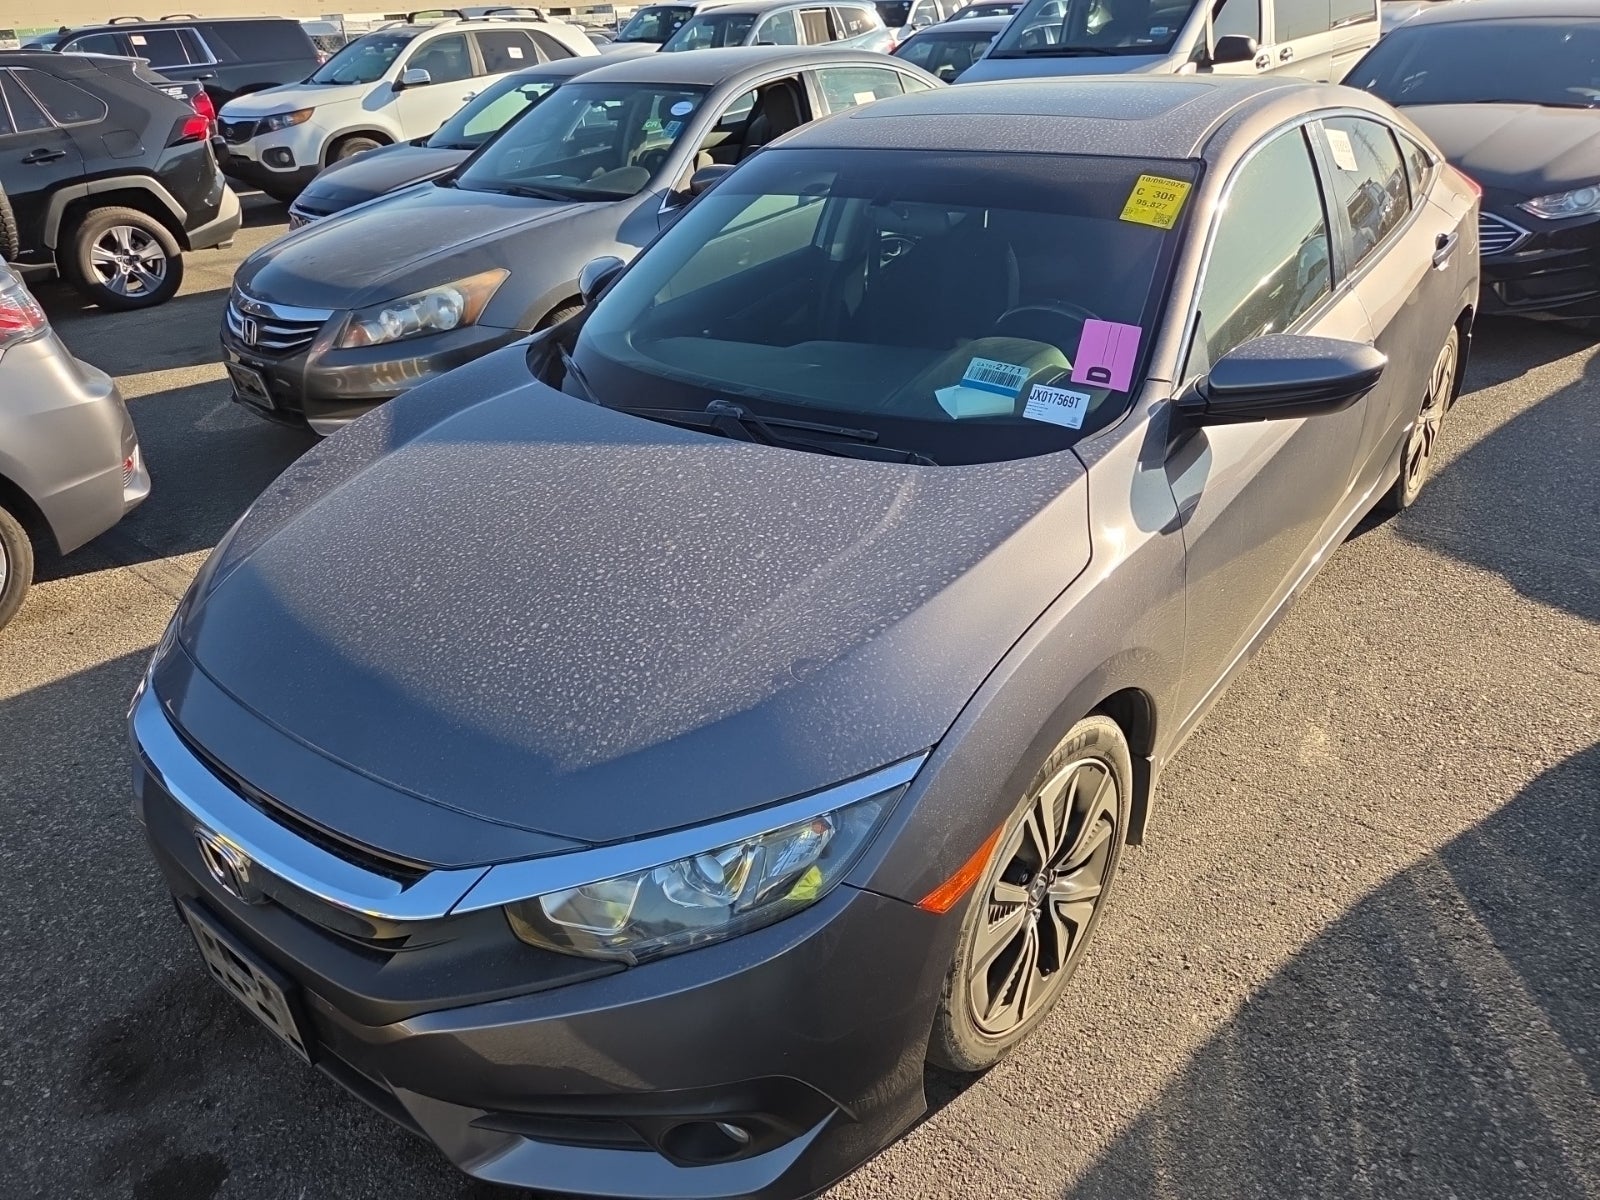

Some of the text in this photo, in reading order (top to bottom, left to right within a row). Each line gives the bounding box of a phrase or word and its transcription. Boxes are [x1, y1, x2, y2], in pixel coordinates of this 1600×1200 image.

[1136, 187, 1146, 196] C
[1152, 190, 1177, 202] 308
[1085, 366, 1112, 385] D
[1029, 388, 1082, 409] JX017569T
